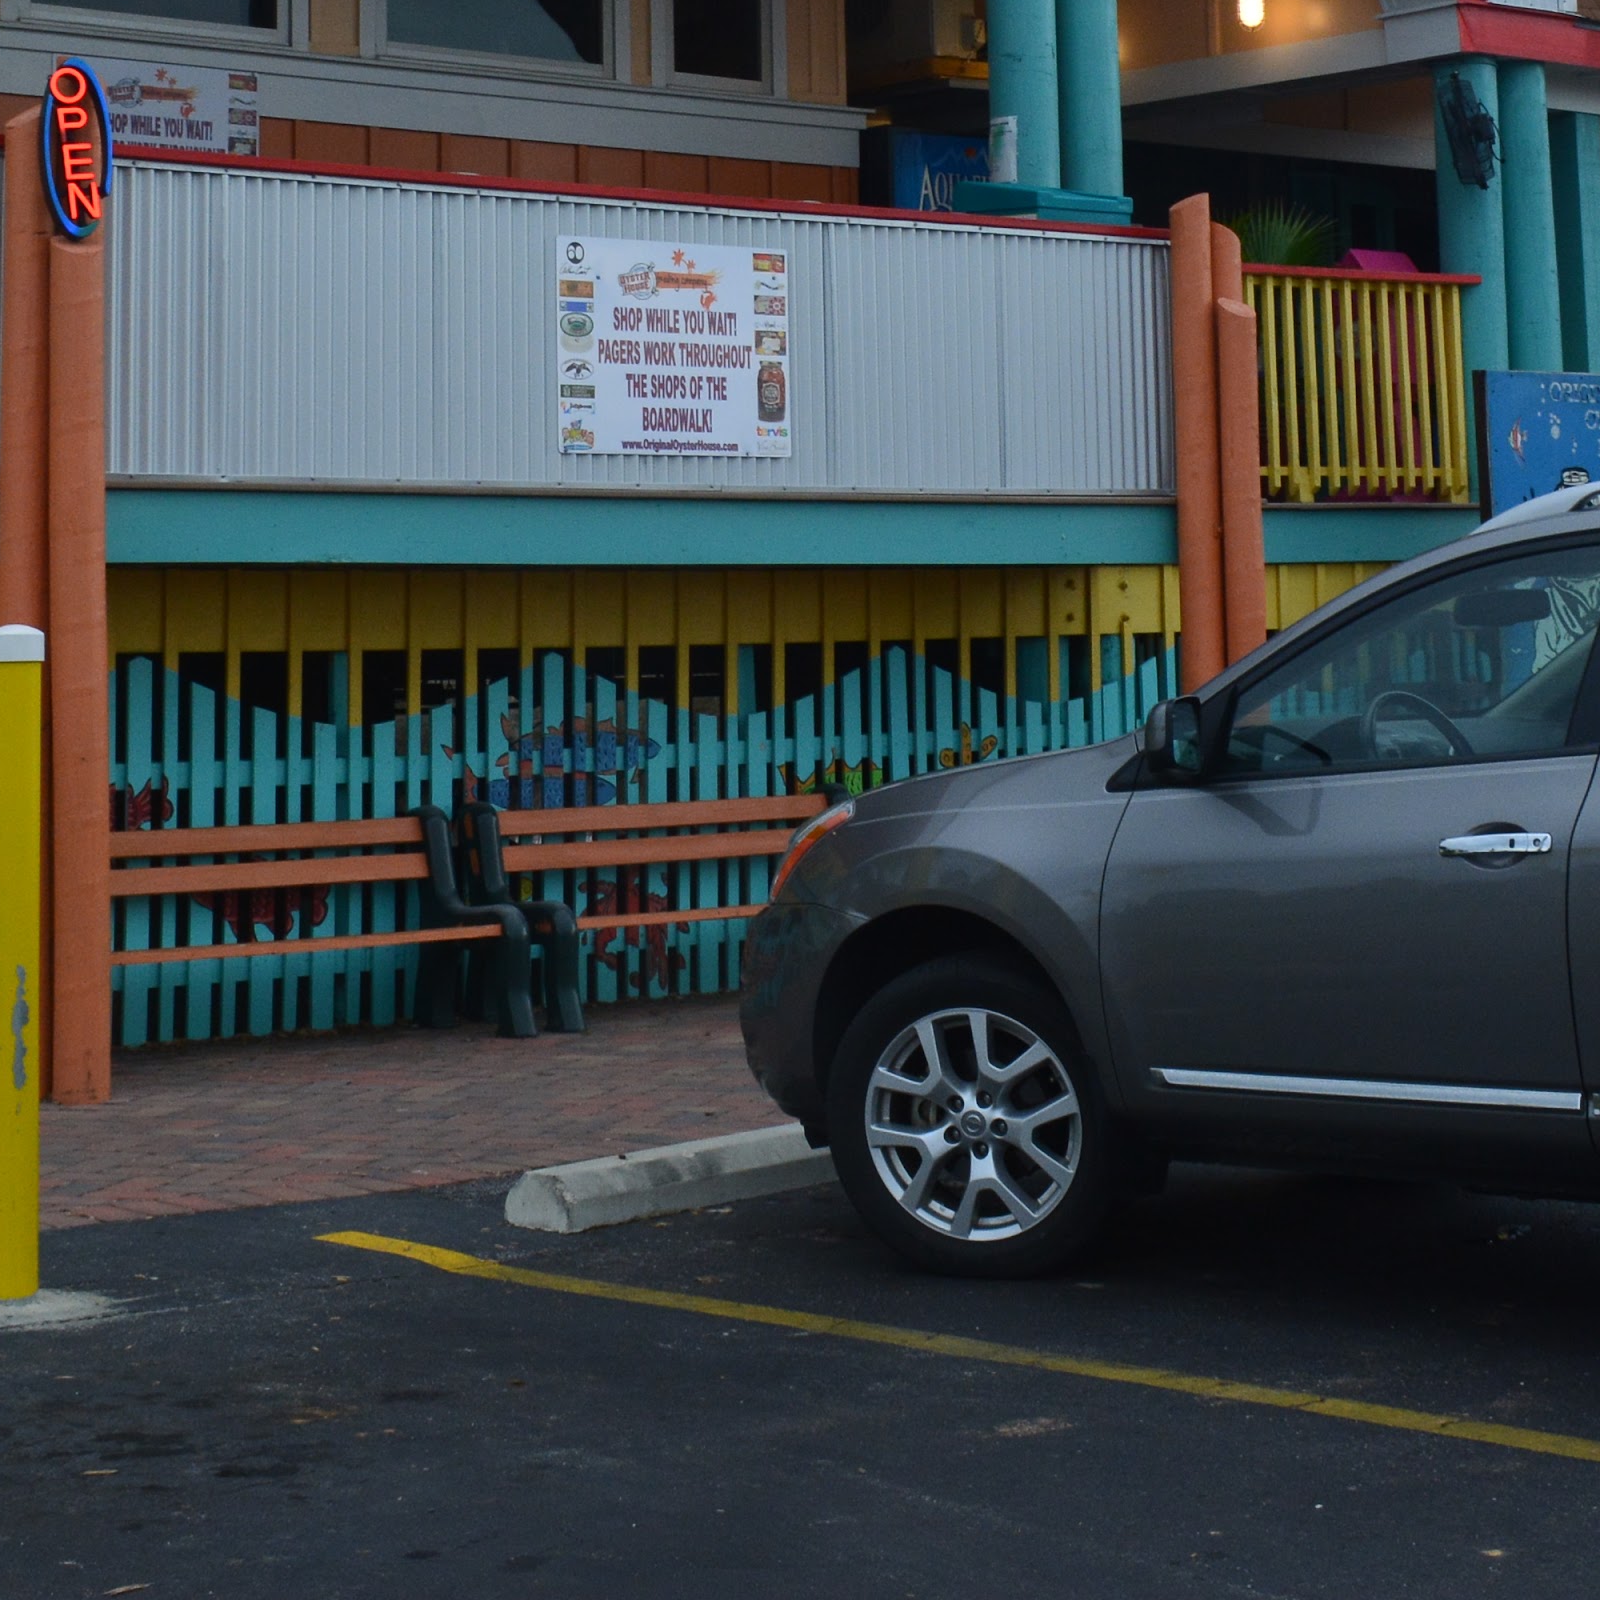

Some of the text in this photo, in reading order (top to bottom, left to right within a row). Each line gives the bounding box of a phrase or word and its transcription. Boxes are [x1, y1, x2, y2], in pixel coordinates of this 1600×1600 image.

[110, 113, 213, 141] HOP WHILE YOU WAIT!
[50, 67, 102, 219] OPEN
[619, 271, 650, 285] OYSTER
[624, 281, 650, 294] HOUSE
[613, 306, 738, 337] SHOP WHILE YOU WAIT!
[598, 339, 752, 369] PAGERS WORK THROUGHOUT
[625, 373, 728, 401] THE SHOPS OF THE
[642, 407, 713, 433] BOARDWALK!
[756, 426, 788, 437] tervis
[621, 438, 739, 453] www.OriginalOysterHouse.com
